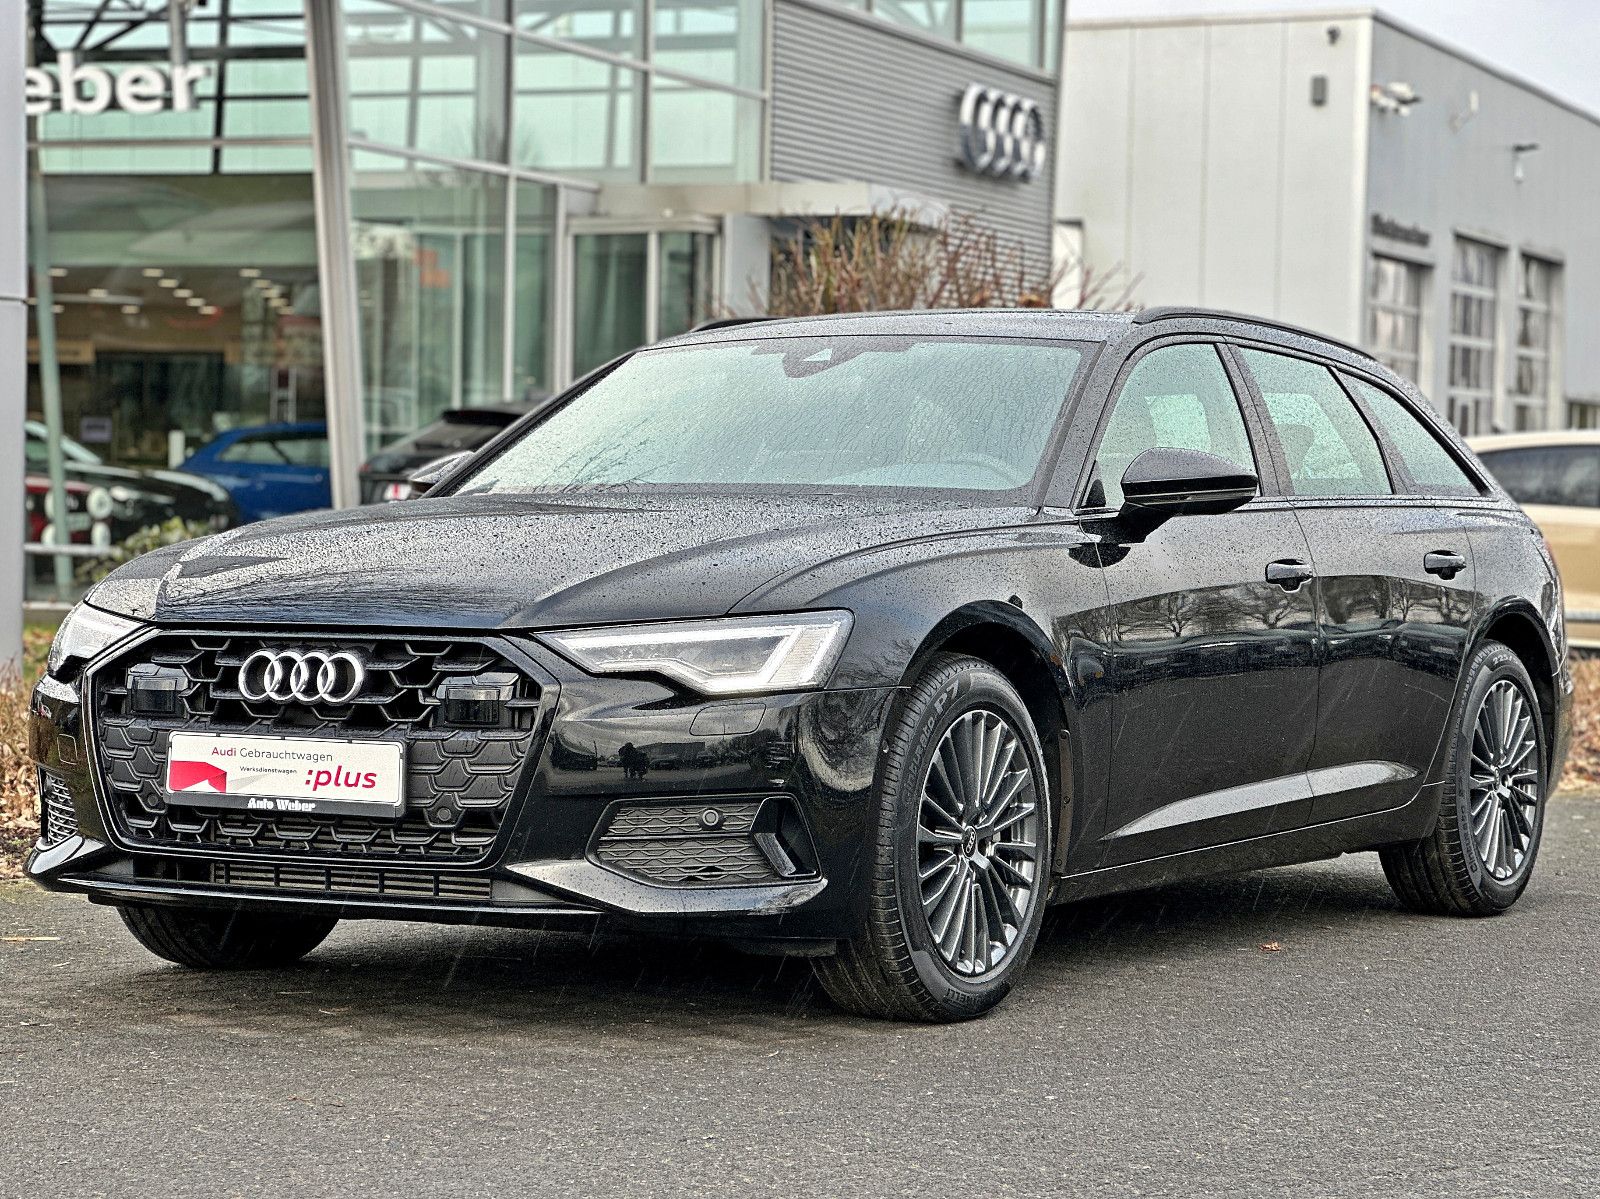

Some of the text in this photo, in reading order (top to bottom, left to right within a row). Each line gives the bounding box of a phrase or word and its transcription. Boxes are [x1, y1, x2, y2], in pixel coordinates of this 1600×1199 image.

[933, 678, 959, 714] P7
[211, 746, 333, 762] Audi Gebrauchtwagen
[239, 765, 298, 775] Werksdienstwagen
[304, 765, 378, 791] :plus
[248, 798, 316, 812] Auto Weber
